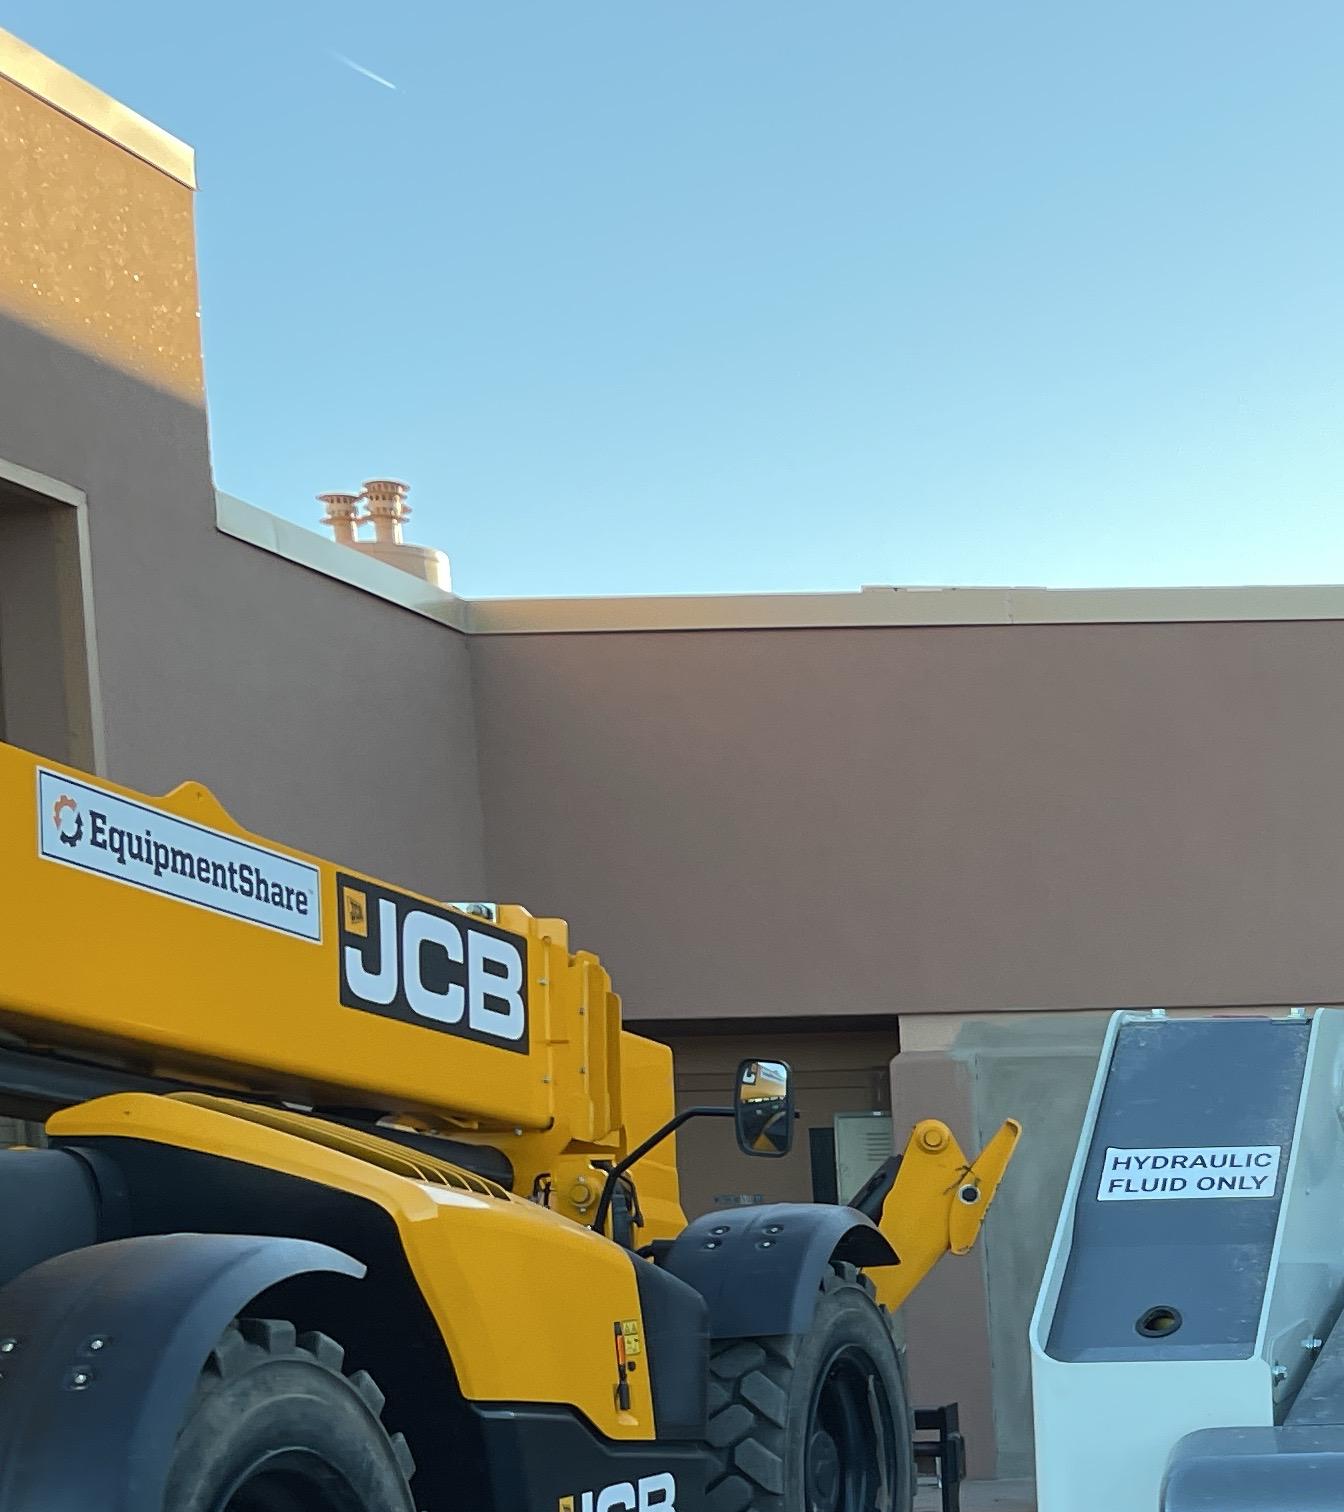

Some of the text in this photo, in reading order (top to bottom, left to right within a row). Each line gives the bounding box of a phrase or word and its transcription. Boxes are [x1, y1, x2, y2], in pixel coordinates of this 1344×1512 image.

[89, 809, 308, 915] EquipmentShare
[345, 898, 524, 1040] JCB
[1108, 1175, 1269, 1193] FLUID ONLY
[1112, 1153, 1272, 1171] HYDRAULIC
